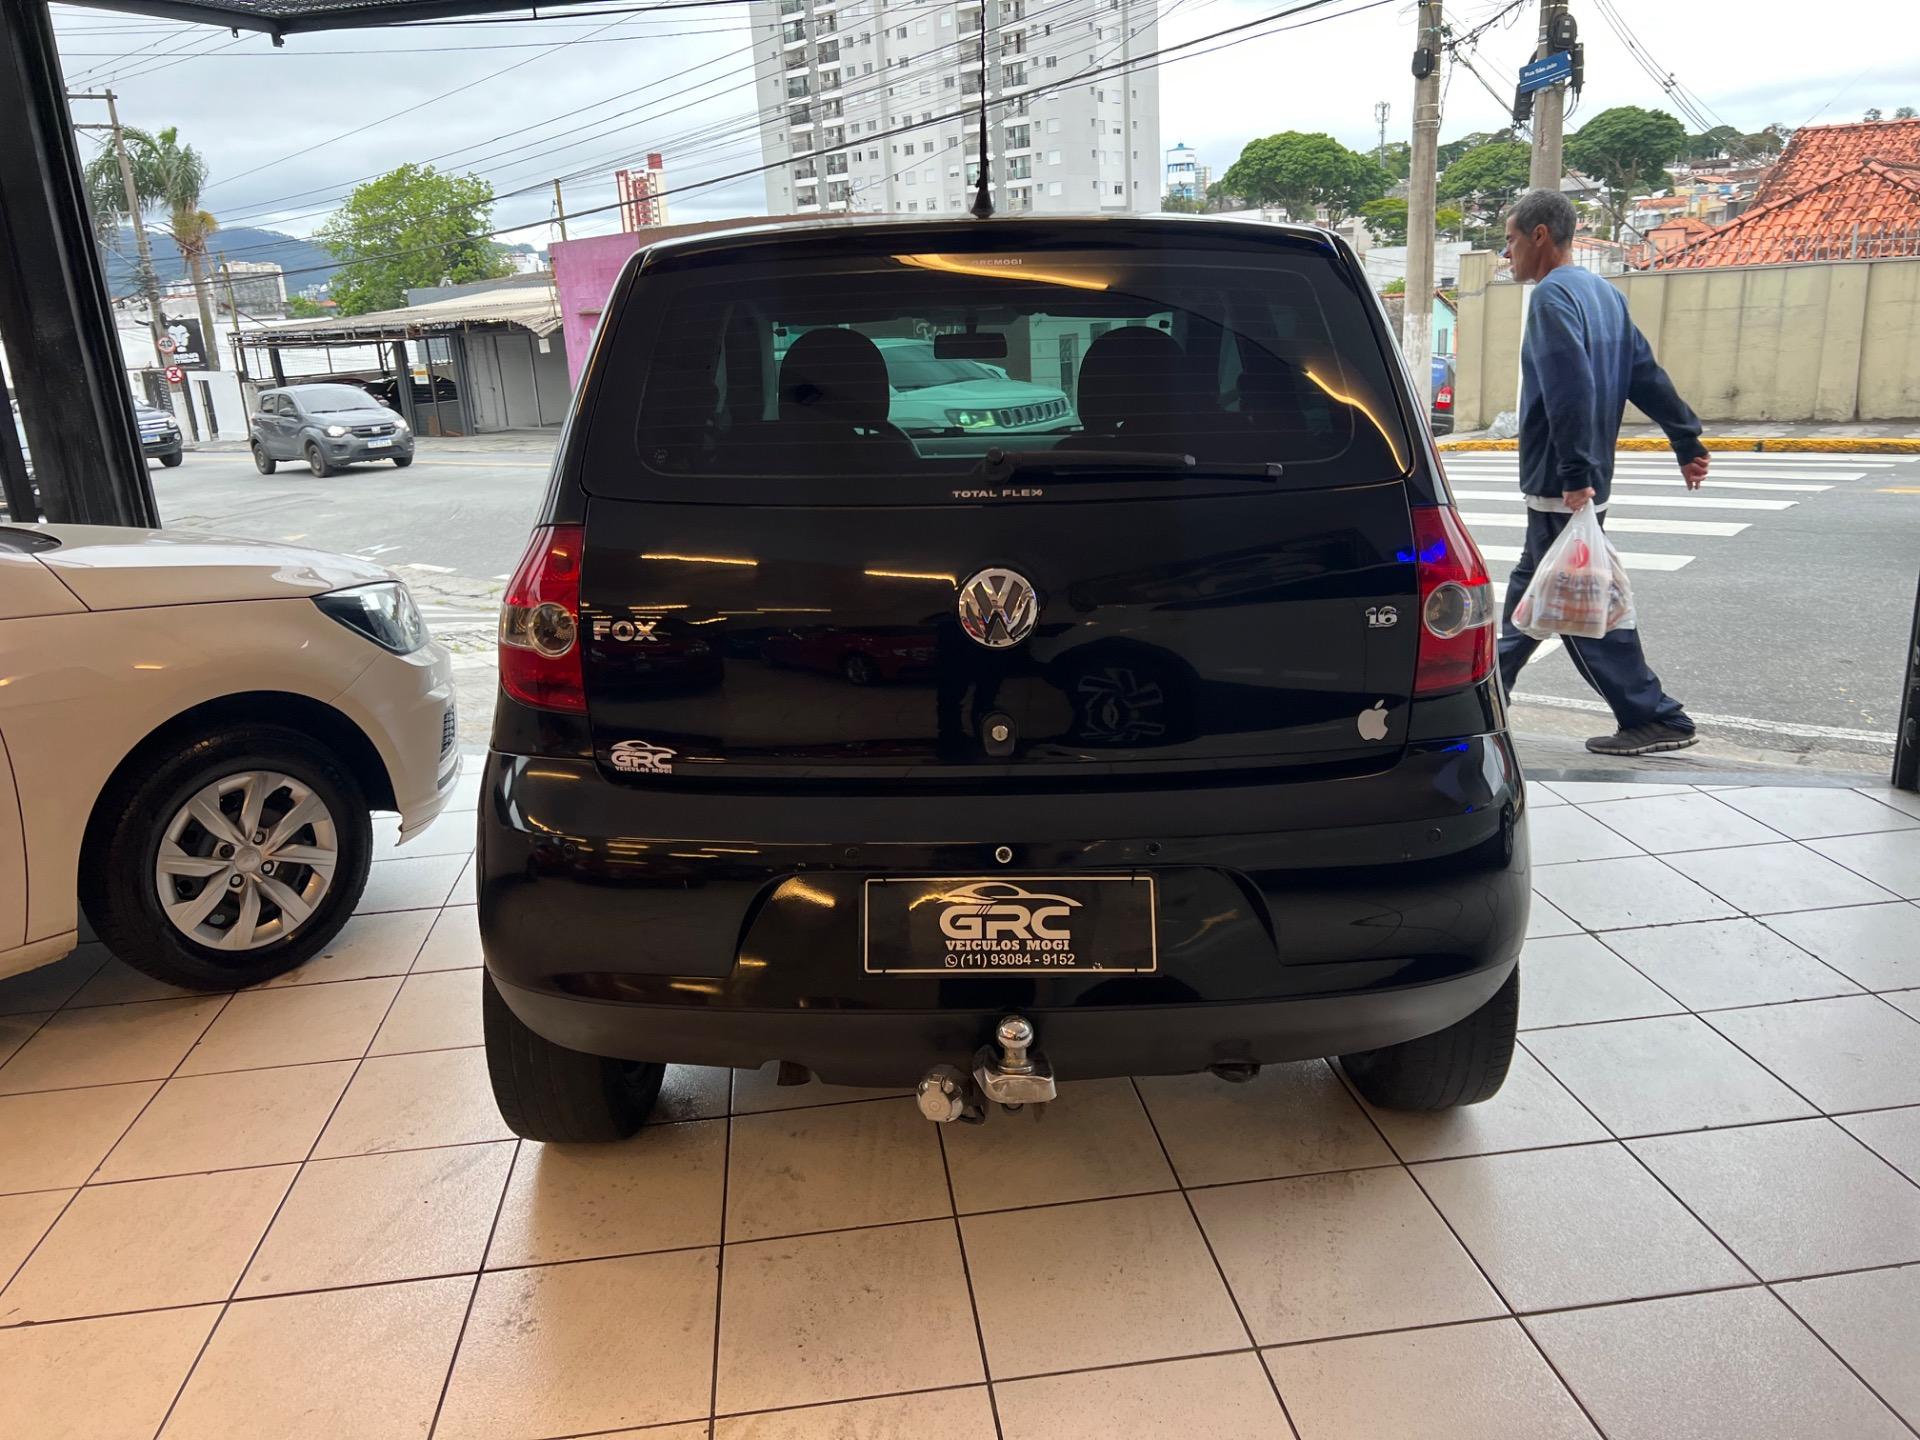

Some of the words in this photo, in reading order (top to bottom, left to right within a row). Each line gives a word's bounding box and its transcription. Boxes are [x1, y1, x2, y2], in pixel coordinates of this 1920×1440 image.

[952, 490, 998, 498] TOTAL
[1002, 489, 1043, 497] FLEX
[592, 620, 659, 642] FOX
[611, 750, 673, 769] GRC
[939, 905, 1071, 940] GRC
[945, 940, 1020, 951] VEICULOS
[1026, 940, 1070, 951] MOGI
[960, 954, 987, 968] (11)
